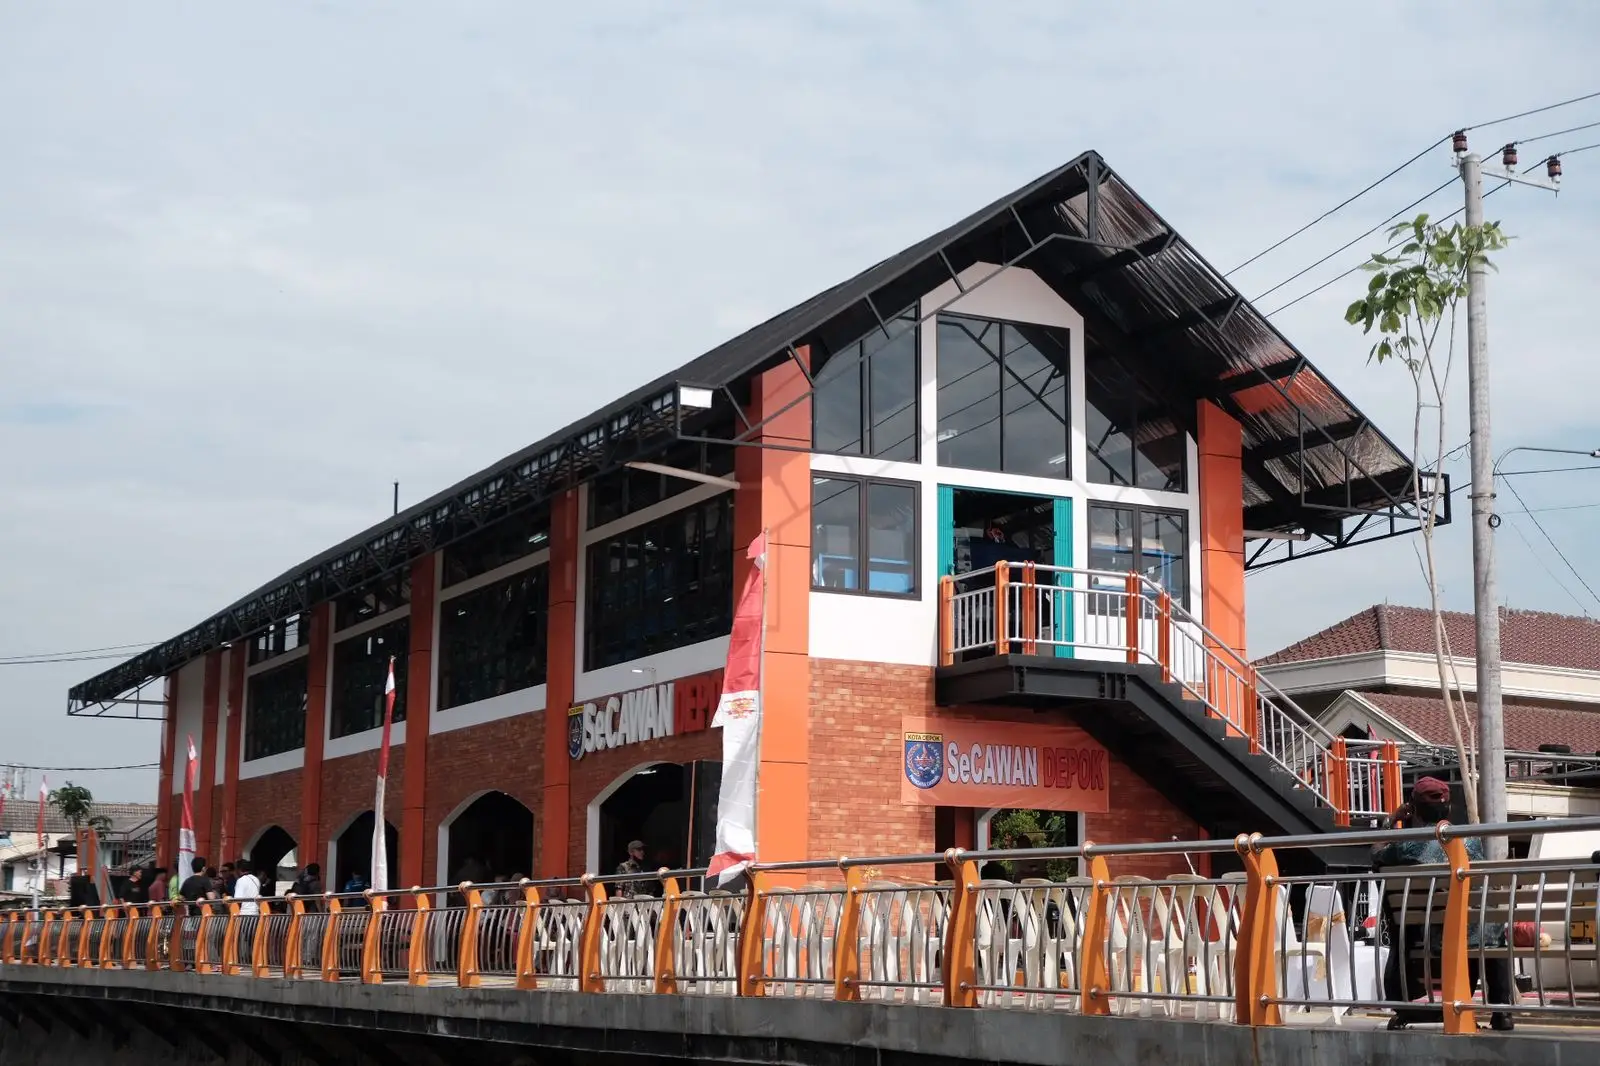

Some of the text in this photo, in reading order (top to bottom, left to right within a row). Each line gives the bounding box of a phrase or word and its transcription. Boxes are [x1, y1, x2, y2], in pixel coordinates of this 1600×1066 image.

[583, 668, 724, 753] SeCAWAN DEPO
[947, 741, 1105, 791] SeCAWAN DEPOK
